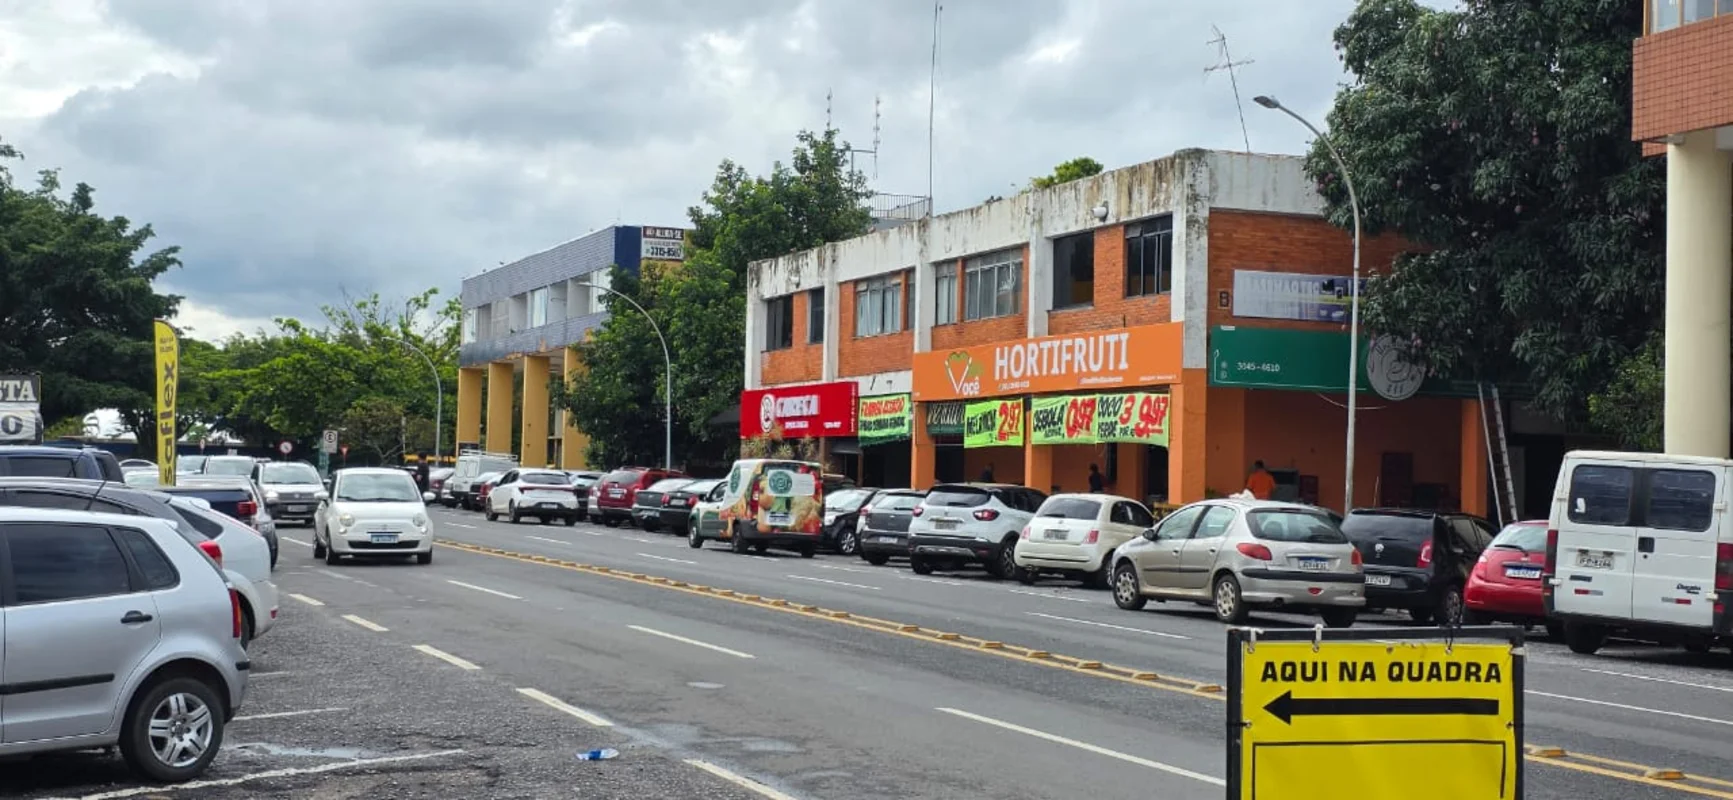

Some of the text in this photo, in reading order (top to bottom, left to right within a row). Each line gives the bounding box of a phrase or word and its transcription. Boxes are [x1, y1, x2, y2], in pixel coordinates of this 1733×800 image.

[994, 332, 1130, 381] HORTIFRUTI
[0, 380, 37, 402] TA
[1097, 396, 1123, 418] COCO
[1119, 394, 1136, 425] 3
[1261, 661, 1502, 683] AQUI NA QUADRA
